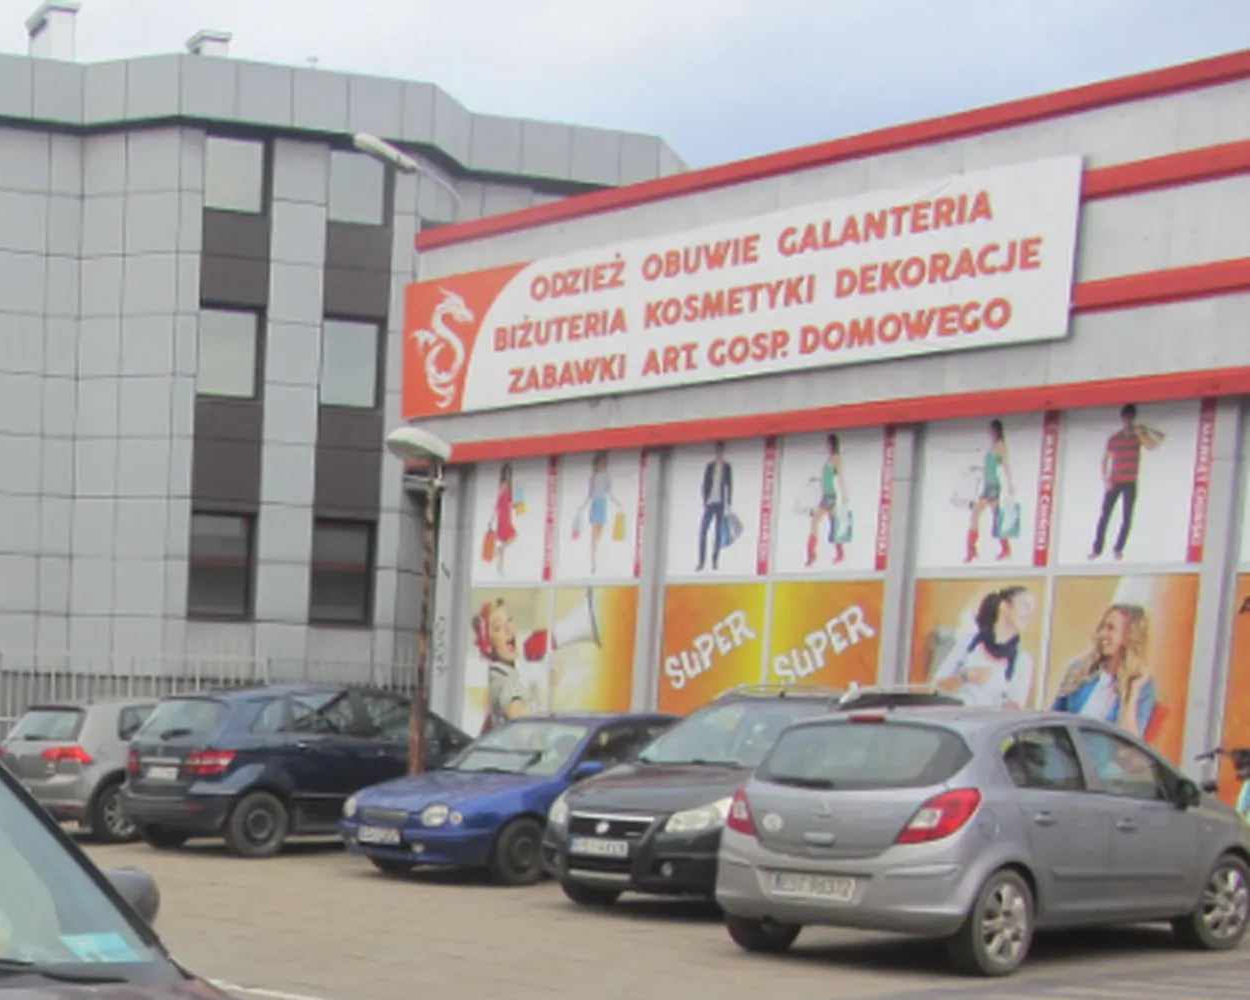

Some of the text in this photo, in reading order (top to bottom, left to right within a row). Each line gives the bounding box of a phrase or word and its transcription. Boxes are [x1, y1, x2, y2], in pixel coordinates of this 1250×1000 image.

[530, 190, 993, 301] ODZIEŻ OBUWIE GALANTERIA
[493, 237, 1043, 353] BIŻUTERIA KOSMETYKI DEKORACJE
[507, 354, 627, 395] ZABAWKI
[707, 329, 790, 368] GOSP.
[798, 297, 1012, 355] DOMOWEGO
[664, 609, 756, 690] SUPER
[773, 604, 875, 689] SUPER
